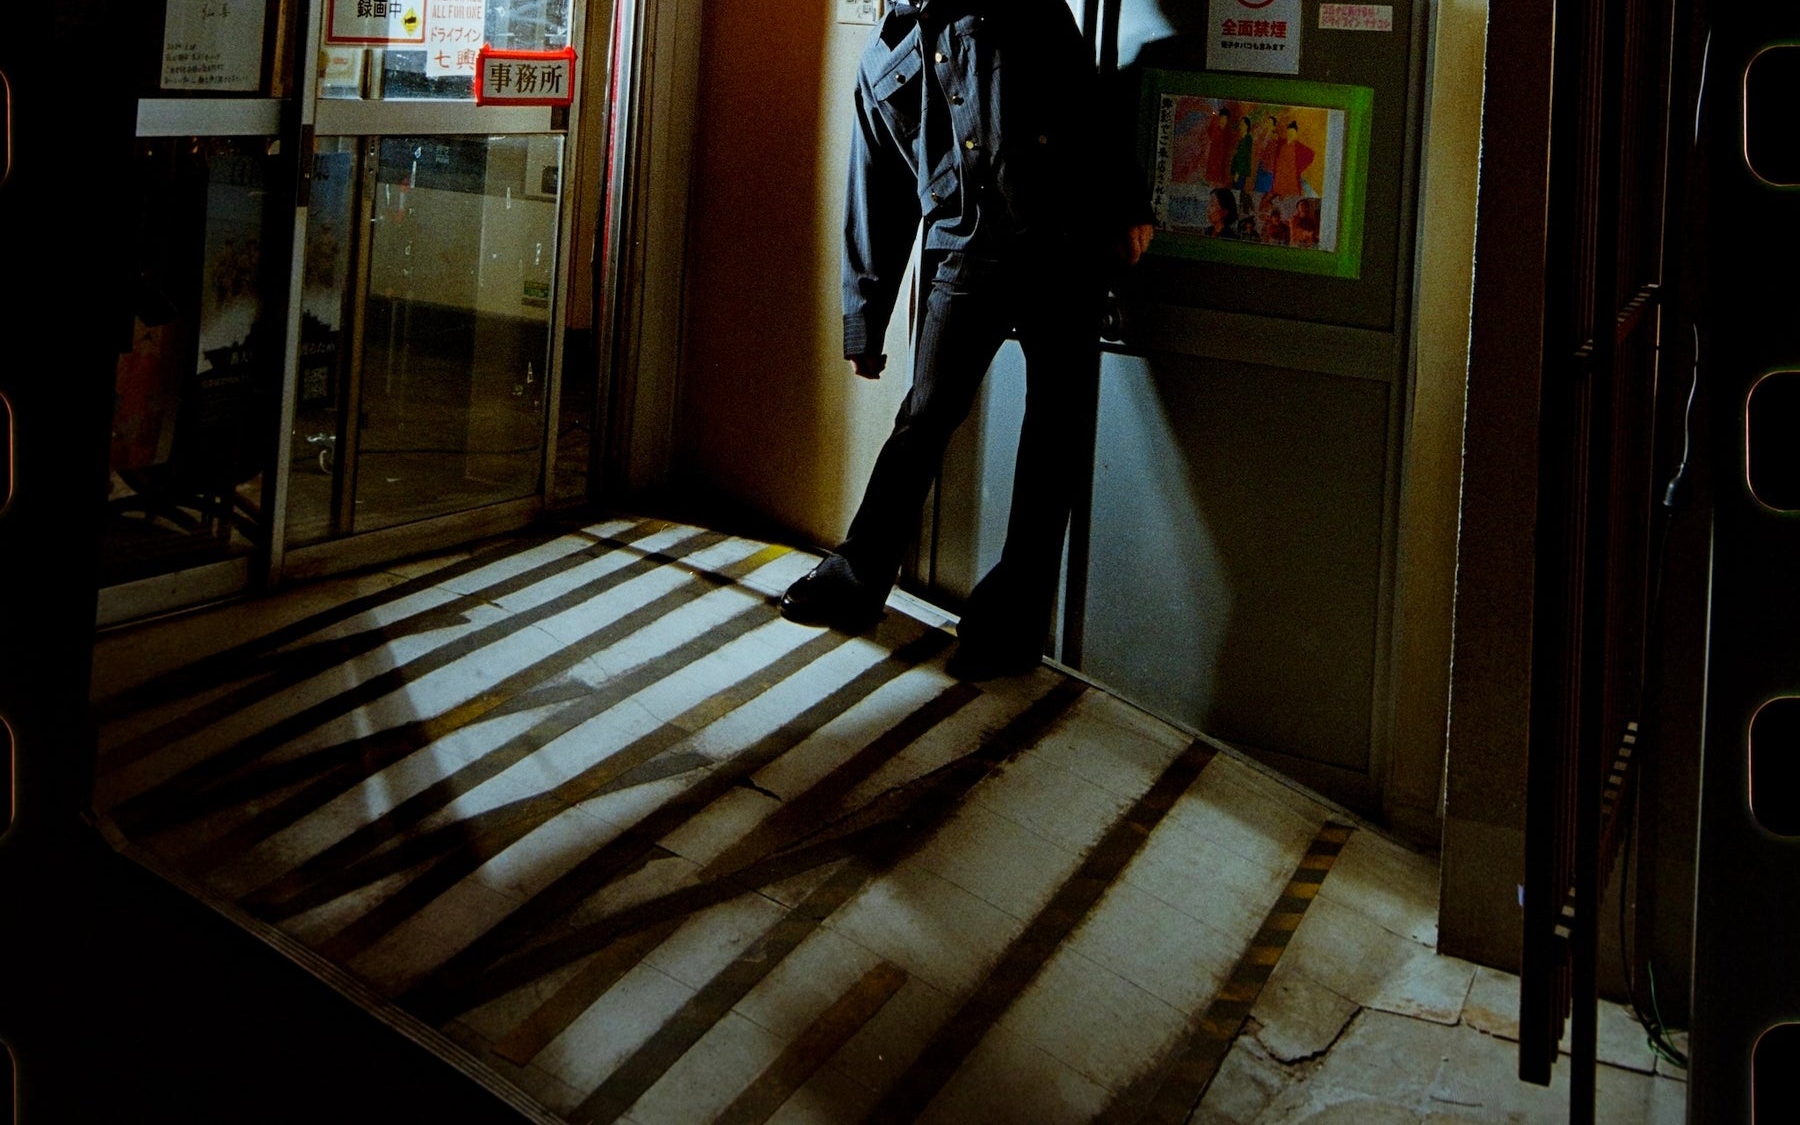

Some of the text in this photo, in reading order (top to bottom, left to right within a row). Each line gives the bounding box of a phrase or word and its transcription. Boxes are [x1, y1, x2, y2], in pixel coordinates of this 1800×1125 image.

[432, 5, 482, 20] ALL FOR ONE
[430, 26, 482, 43] ドライブイン
[1221, 18, 1287, 38] 全面禁煙
[1221, 40, 1286, 51] 電子タバコも含みます
[489, 63, 562, 94] 事務所
